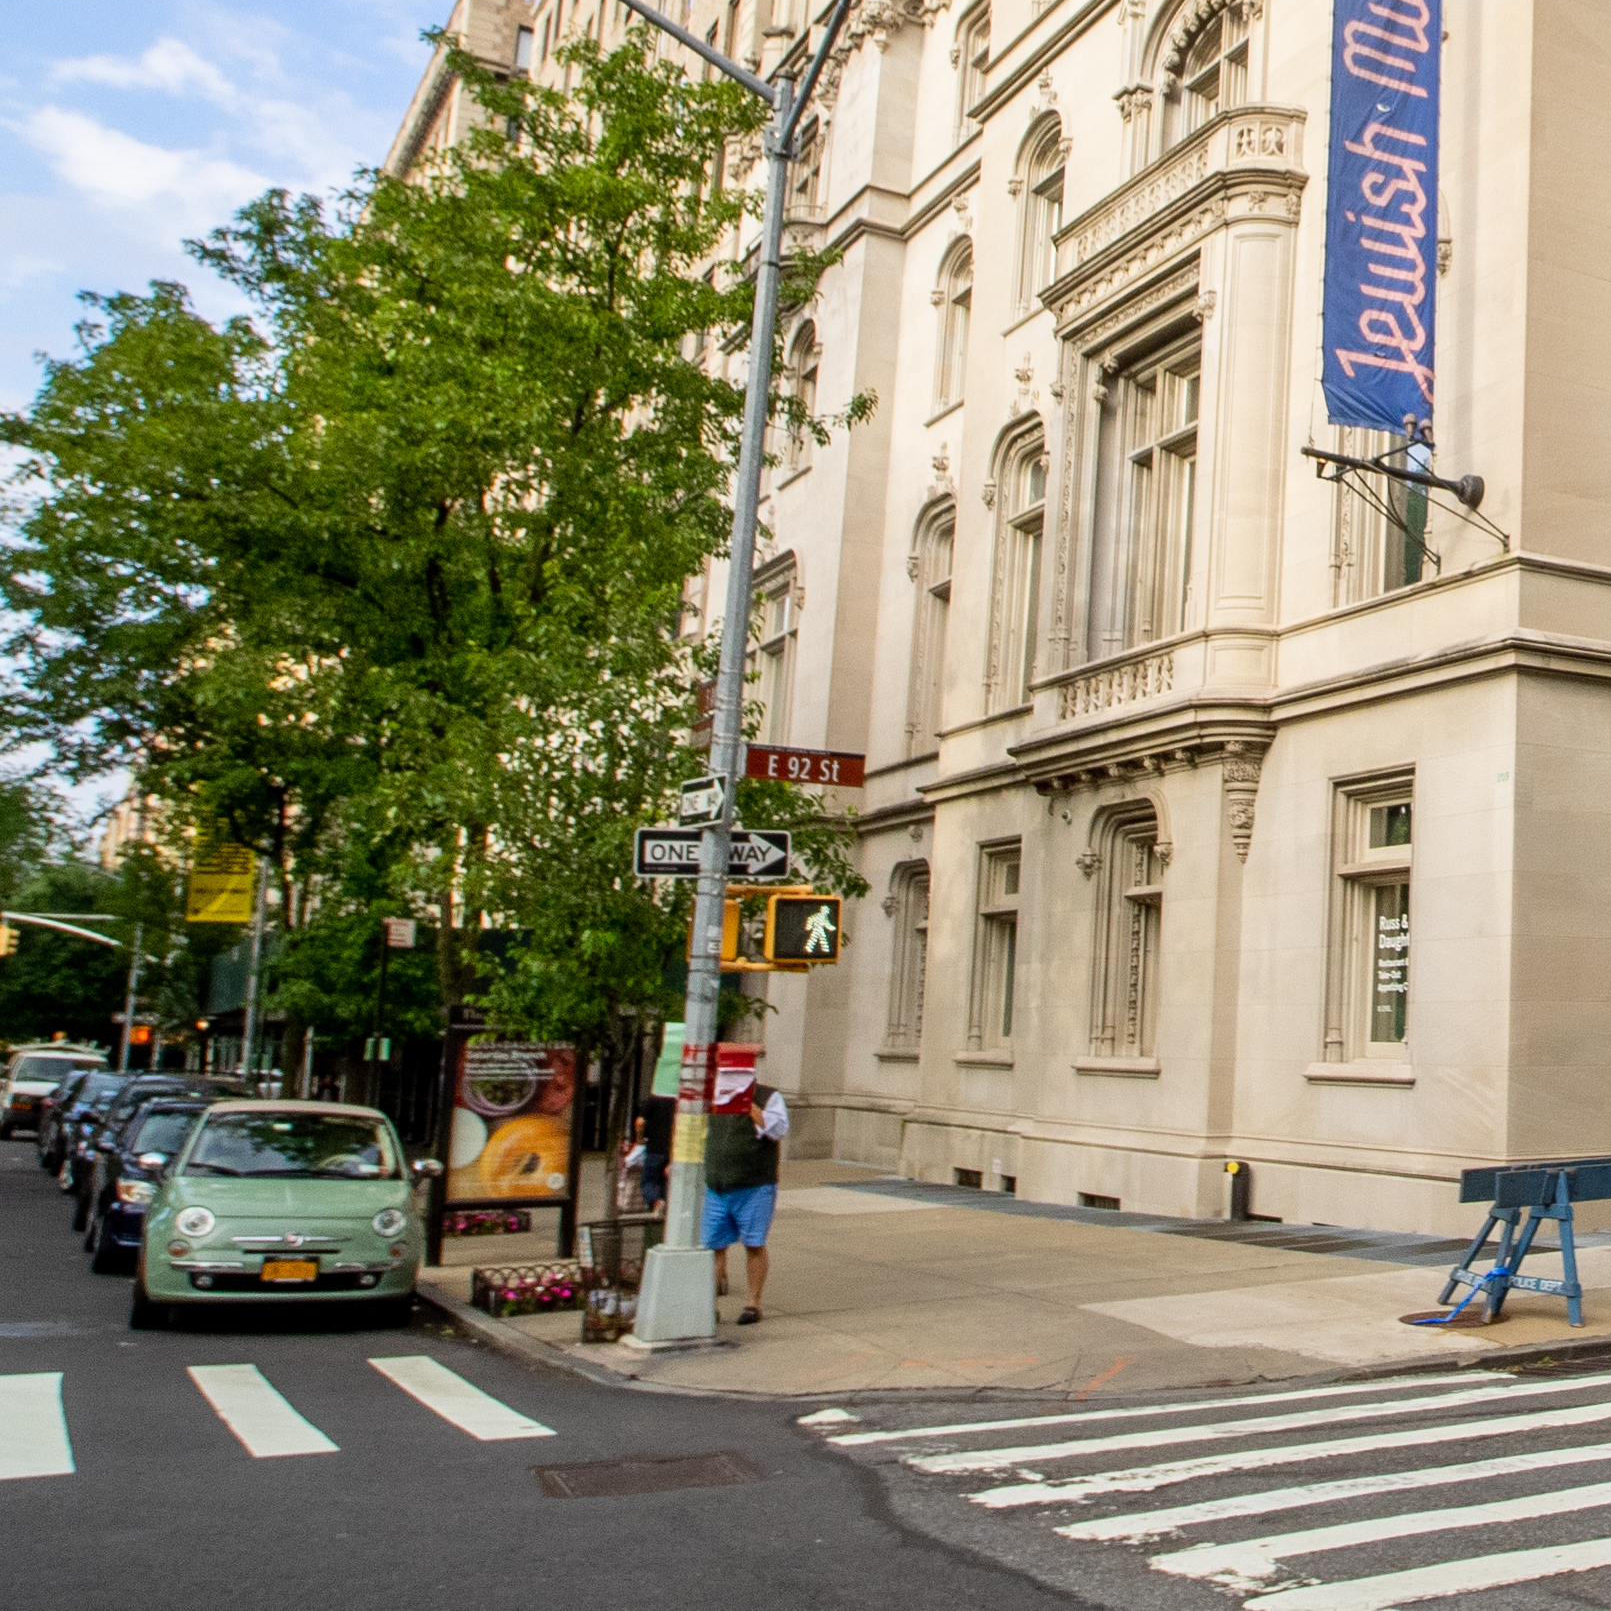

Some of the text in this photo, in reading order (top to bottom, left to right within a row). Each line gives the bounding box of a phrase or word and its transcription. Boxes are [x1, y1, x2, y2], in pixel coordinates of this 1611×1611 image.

[1335, 121, 1435, 404] Jewish
[768, 754, 840, 783] E 92 St
[650, 844, 772, 863] ONE WAY
[1379, 916, 1400, 930] Russ
[1509, 1275, 1537, 1289] POLICE
